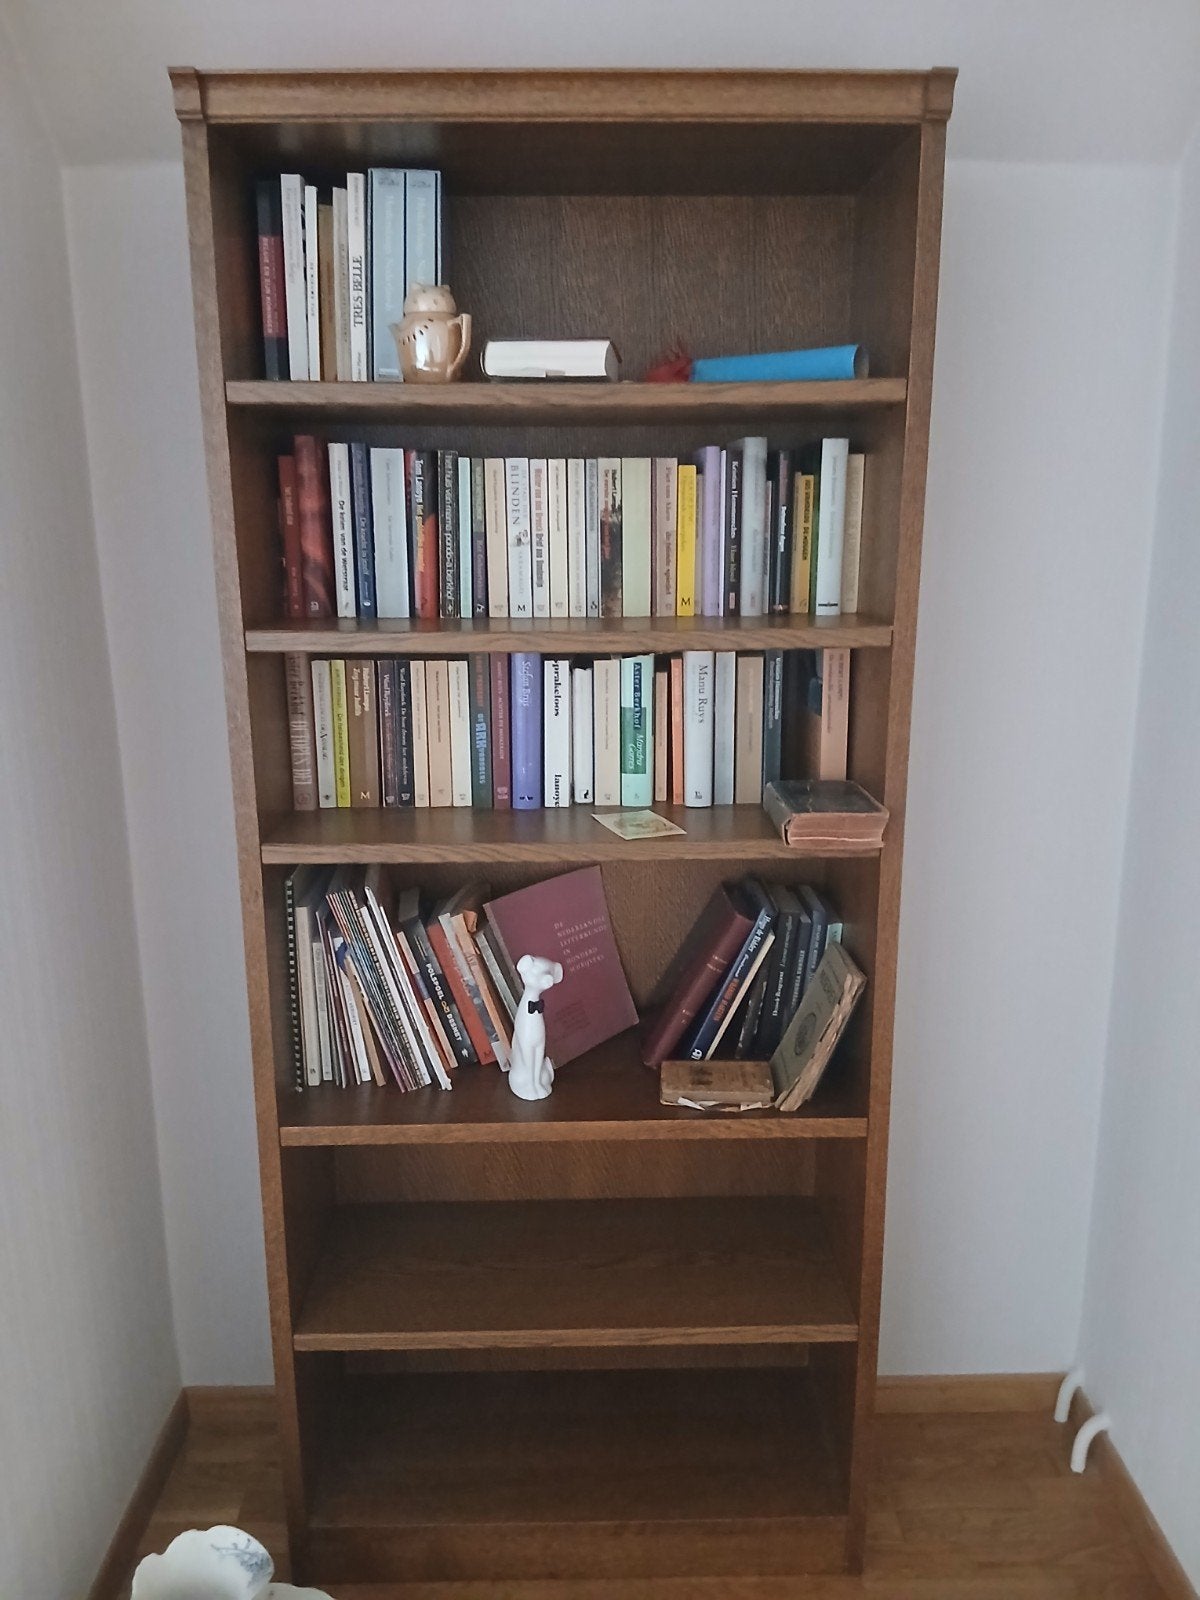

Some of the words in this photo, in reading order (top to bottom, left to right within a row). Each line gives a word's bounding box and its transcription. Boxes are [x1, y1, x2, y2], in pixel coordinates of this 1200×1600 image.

[352, 255, 363, 291] BELLE
[352, 296, 363, 328] TRES
[415, 459, 424, 476] Tom
[445, 471, 453, 487] huis
[730, 460, 739, 489] Kristien
[414, 477, 424, 503] Lanoye
[445, 488, 453, 504] van
[510, 464, 521, 525] BLINDEN
[338, 500, 346, 510] De
[730, 490, 739, 539] Hemmerechts
[360, 517, 368, 526] De
[340, 547, 348, 557] de
[517, 604, 527, 612] M
[681, 597, 691, 607] M
[519, 661, 534, 687] Stefan
[633, 663, 642, 689] Aster
[698, 664, 709, 694] Manu
[337, 713, 344, 722] De
[401, 707, 407, 716] De
[633, 690, 641, 728] Berkhof
[696, 697, 709, 724] Ruys
[290, 720, 312, 765] OCTOPUS
[635, 733, 646, 766] Mandra
[292, 768, 313, 785] DEI
[338, 767, 346, 788] dingen
[562, 948, 571, 956] IN
[425, 962, 445, 1000] POLSPOEL
[446, 1013, 463, 1041] DESMET
